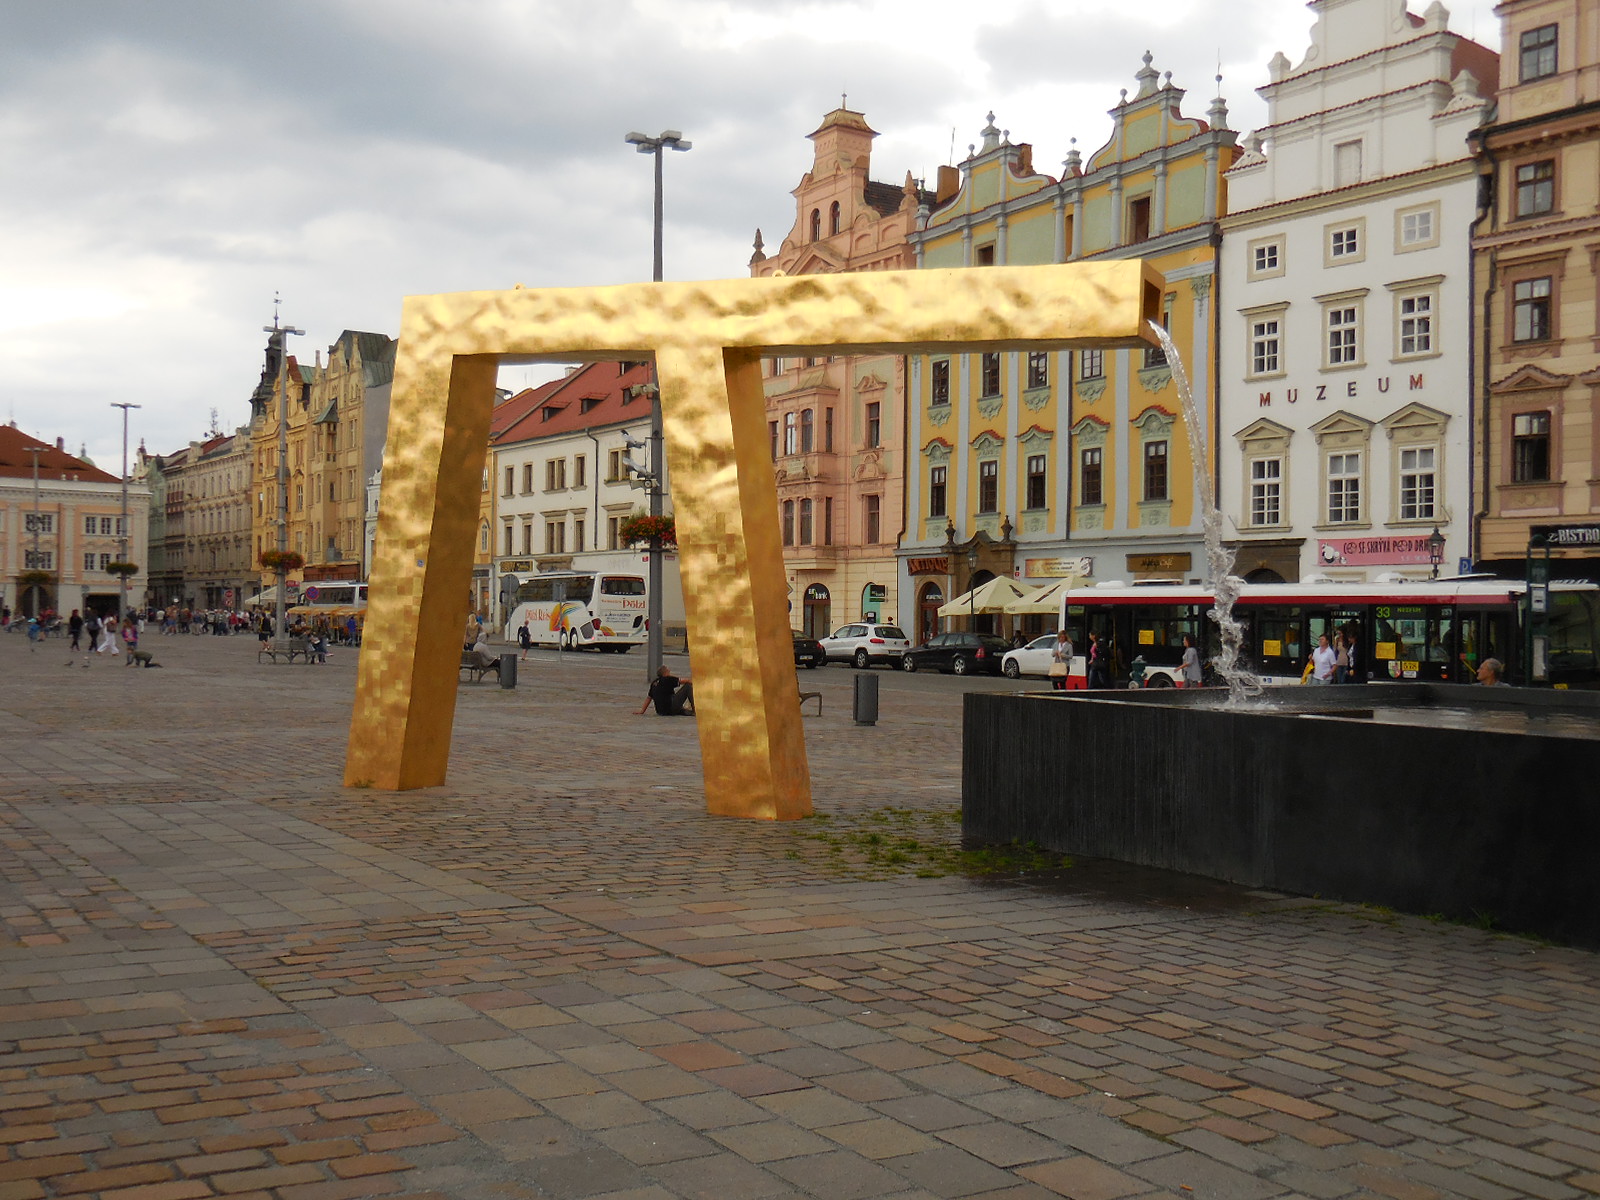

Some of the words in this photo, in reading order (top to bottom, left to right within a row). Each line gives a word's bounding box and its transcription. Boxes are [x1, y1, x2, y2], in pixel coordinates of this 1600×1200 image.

[1259, 373, 1423, 408] MUZEUM
[1358, 541, 1365, 554] SE
[1375, 606, 1391, 618] 33
